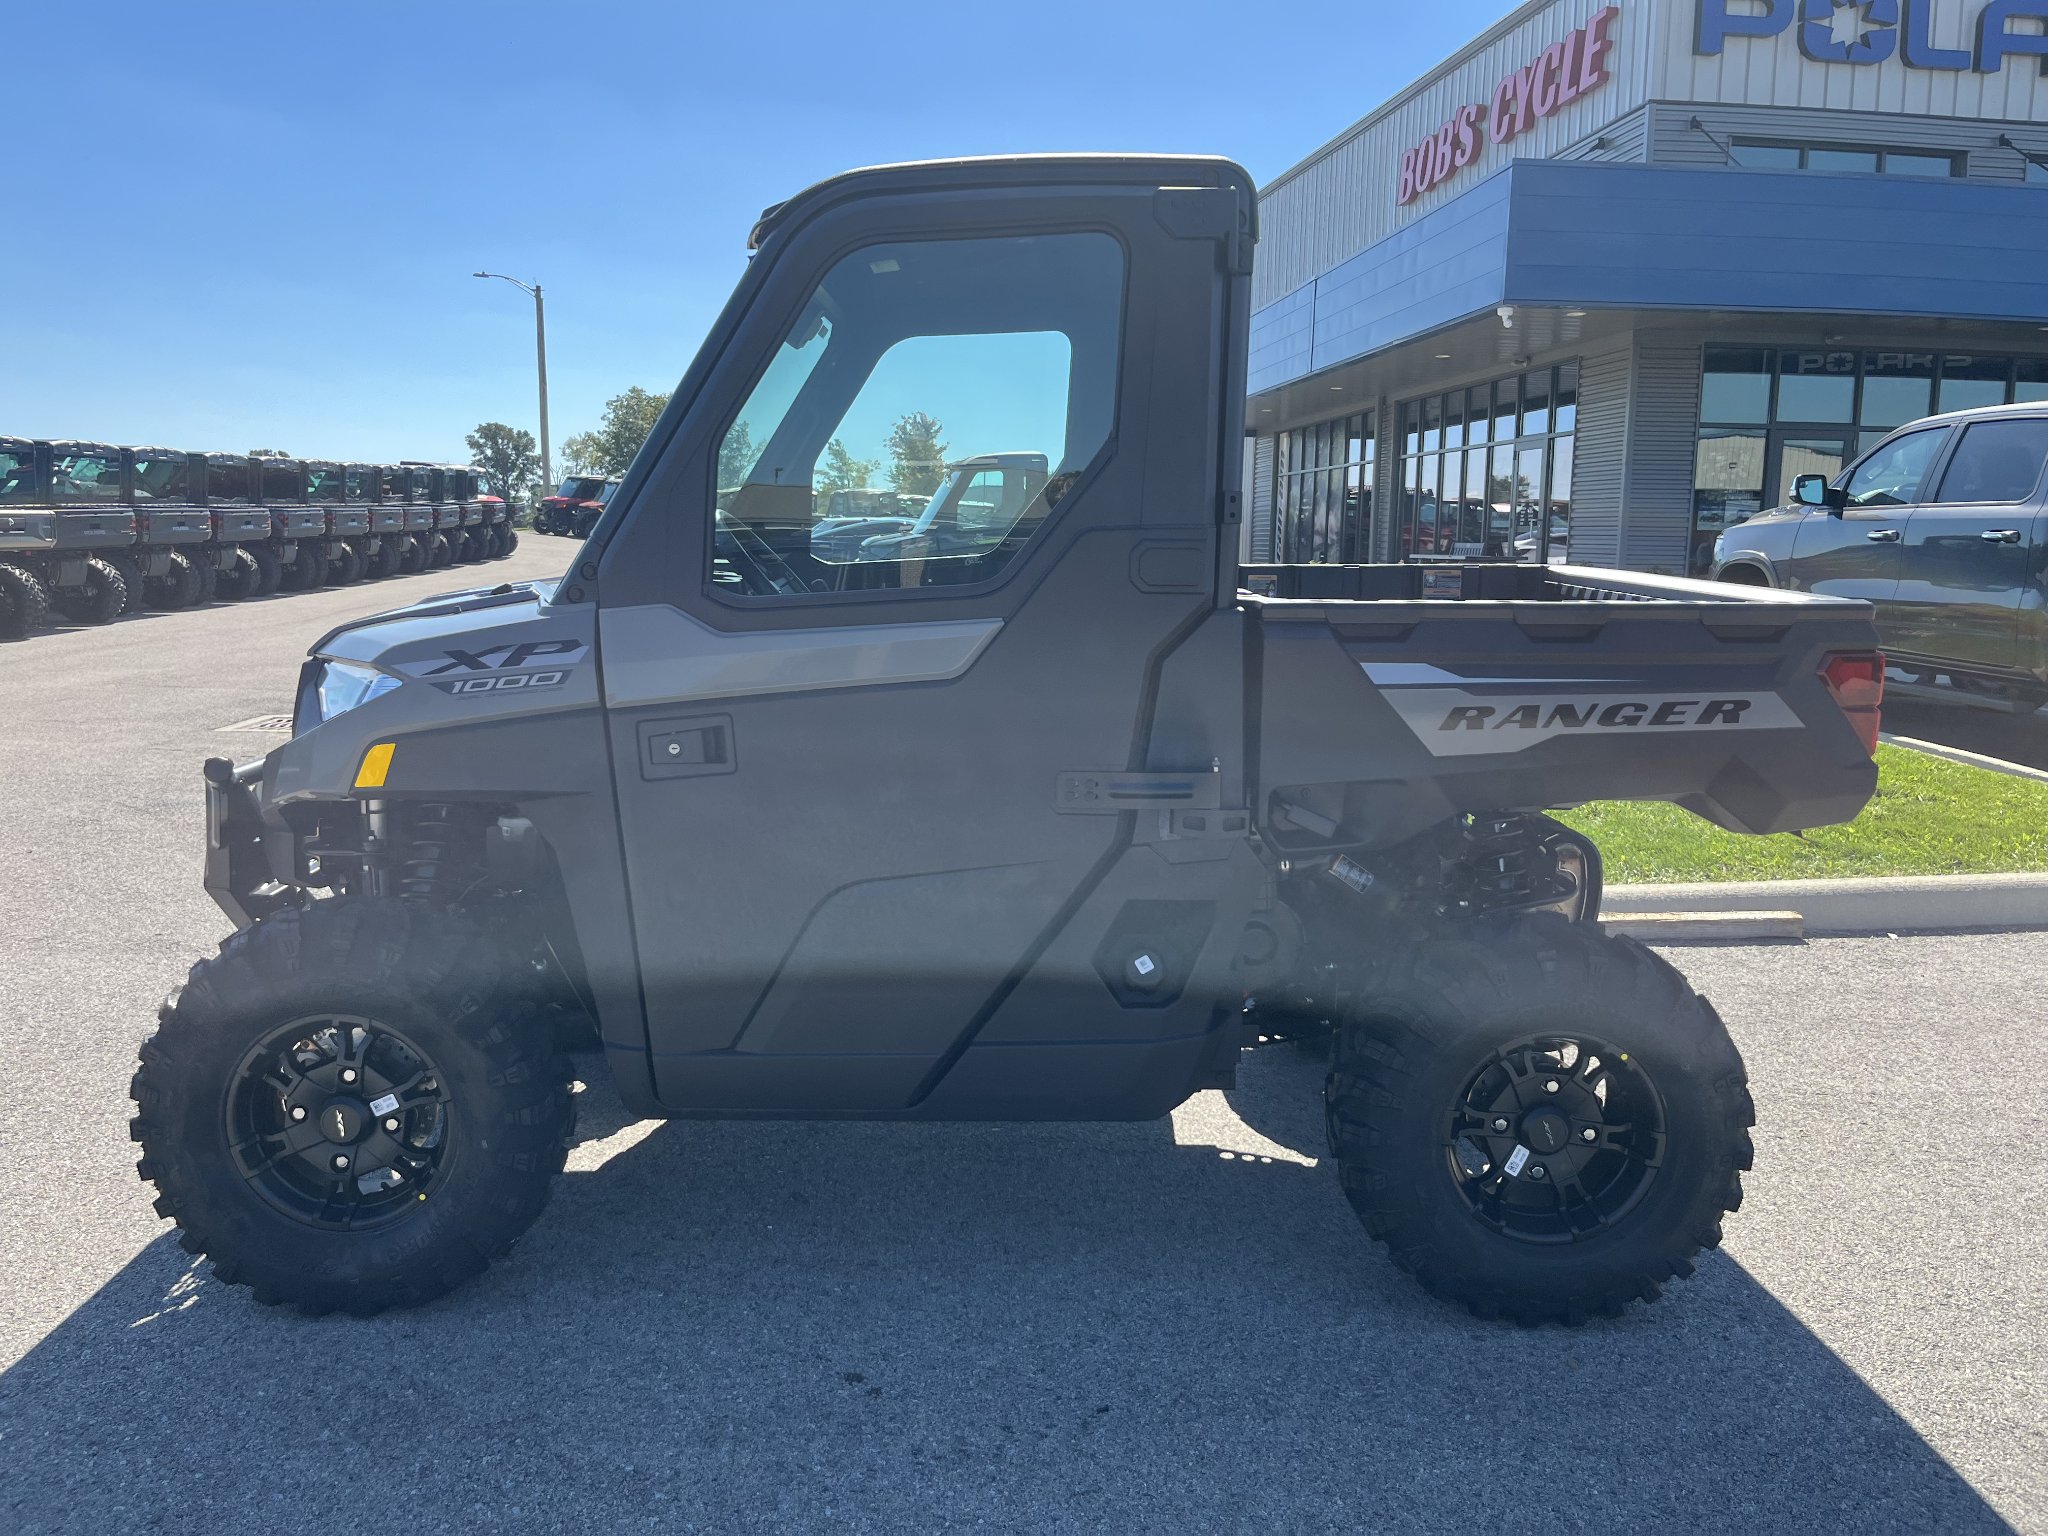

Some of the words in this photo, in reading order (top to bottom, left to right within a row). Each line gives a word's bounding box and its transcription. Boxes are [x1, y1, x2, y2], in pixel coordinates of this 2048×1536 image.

[1397, 103, 1486, 206] BOB'S
[1489, 6, 1618, 144] CYCLE
[420, 638, 585, 676] XP
[451, 671, 563, 694] 1000
[1438, 699, 1752, 731] RANGER
